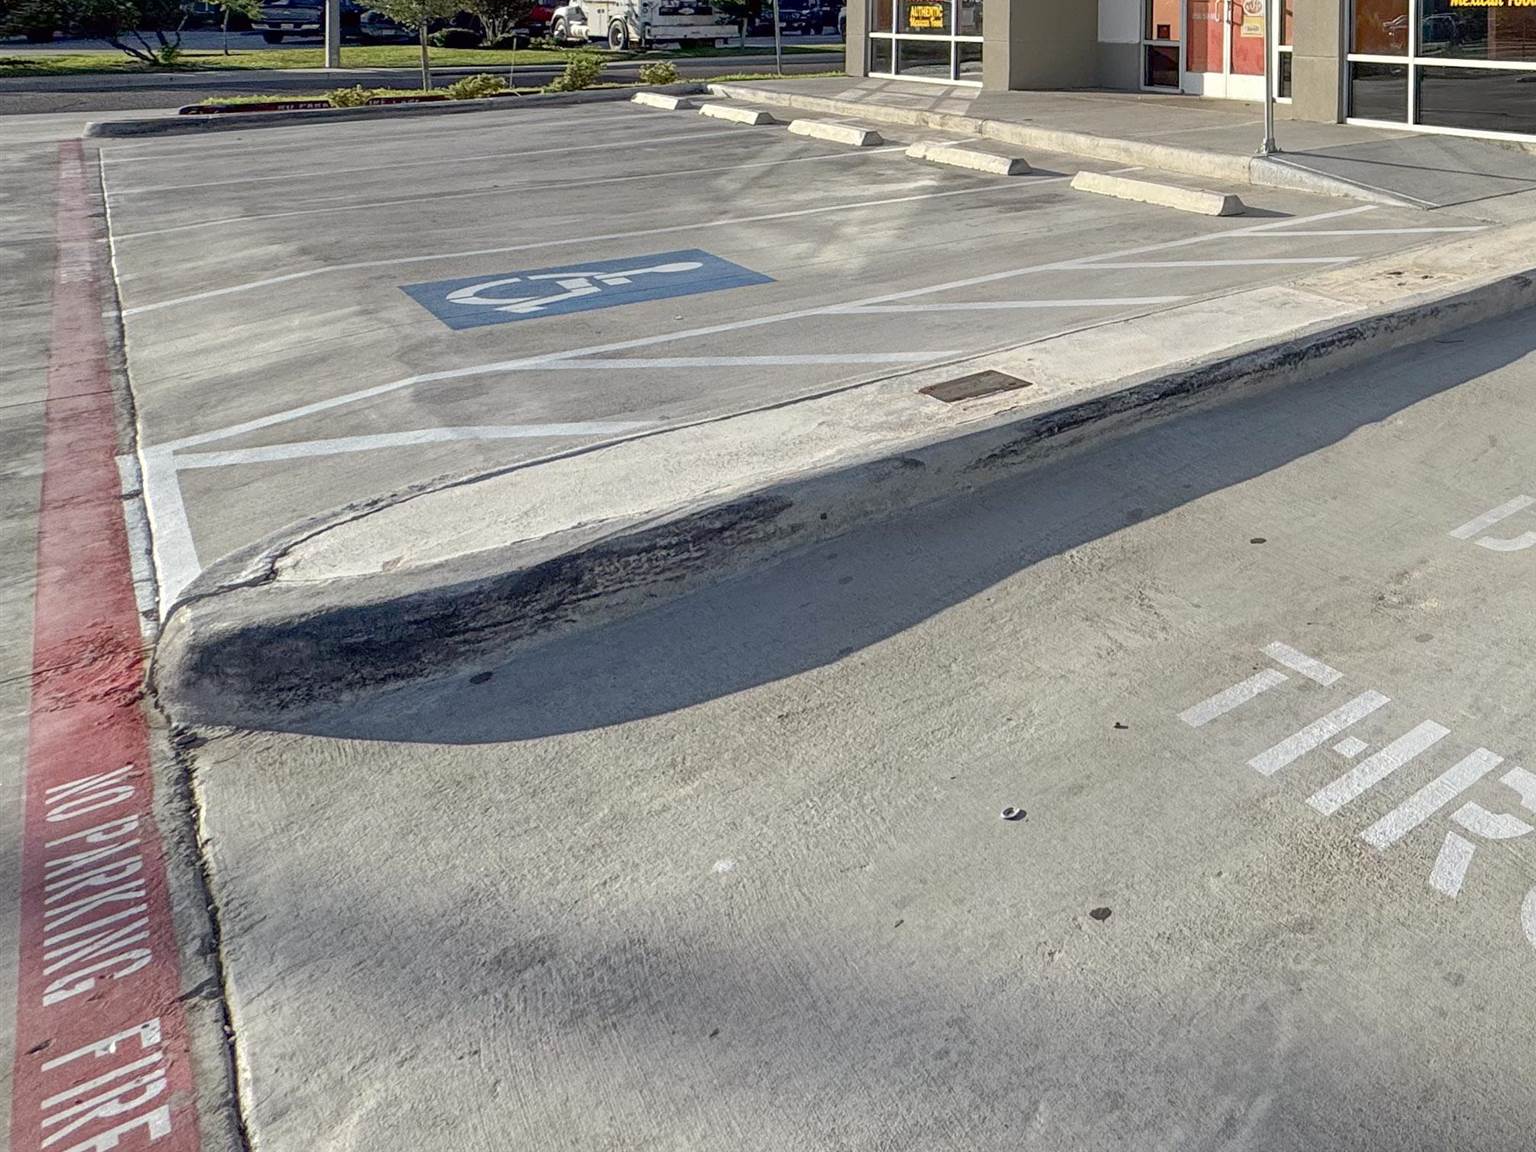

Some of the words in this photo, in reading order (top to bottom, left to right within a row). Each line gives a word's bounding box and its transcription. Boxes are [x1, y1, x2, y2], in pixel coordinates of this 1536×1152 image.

[910, 5, 943, 17] AUTHENTIC
[45, 764, 135, 822] NO
[42, 814, 153, 1007] PARKING
